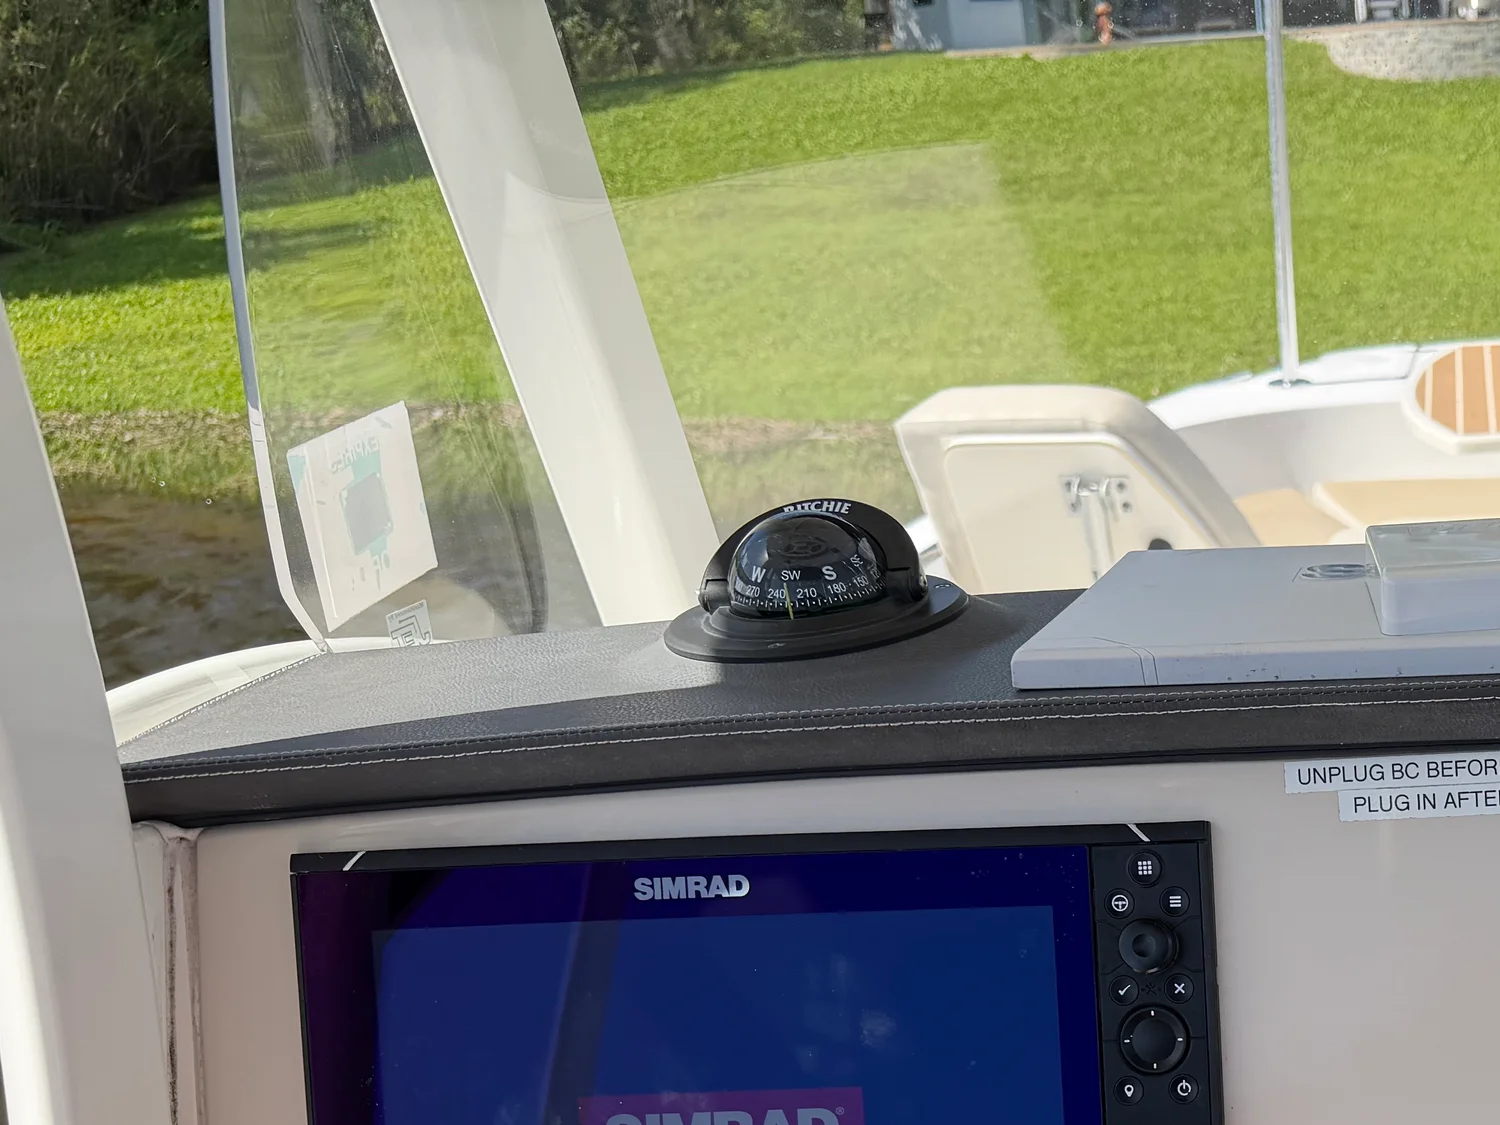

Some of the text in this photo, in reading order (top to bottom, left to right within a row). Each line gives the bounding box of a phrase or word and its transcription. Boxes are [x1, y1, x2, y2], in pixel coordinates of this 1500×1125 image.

[783, 501, 851, 514] RITCHIE
[752, 565, 766, 583] W
[781, 570, 801, 581] SW
[822, 565, 837, 580] S
[767, 589, 786, 599] 240
[796, 587, 817, 598] 210
[827, 583, 846, 595] 180
[853, 576, 869, 588] 150
[1298, 763, 1384, 785] UNPLUG
[1392, 762, 1420, 780] BC
[1354, 794, 1410, 813] PLUG
[1417, 793, 1437, 811] IN
[634, 874, 750, 901] SIMRAD
